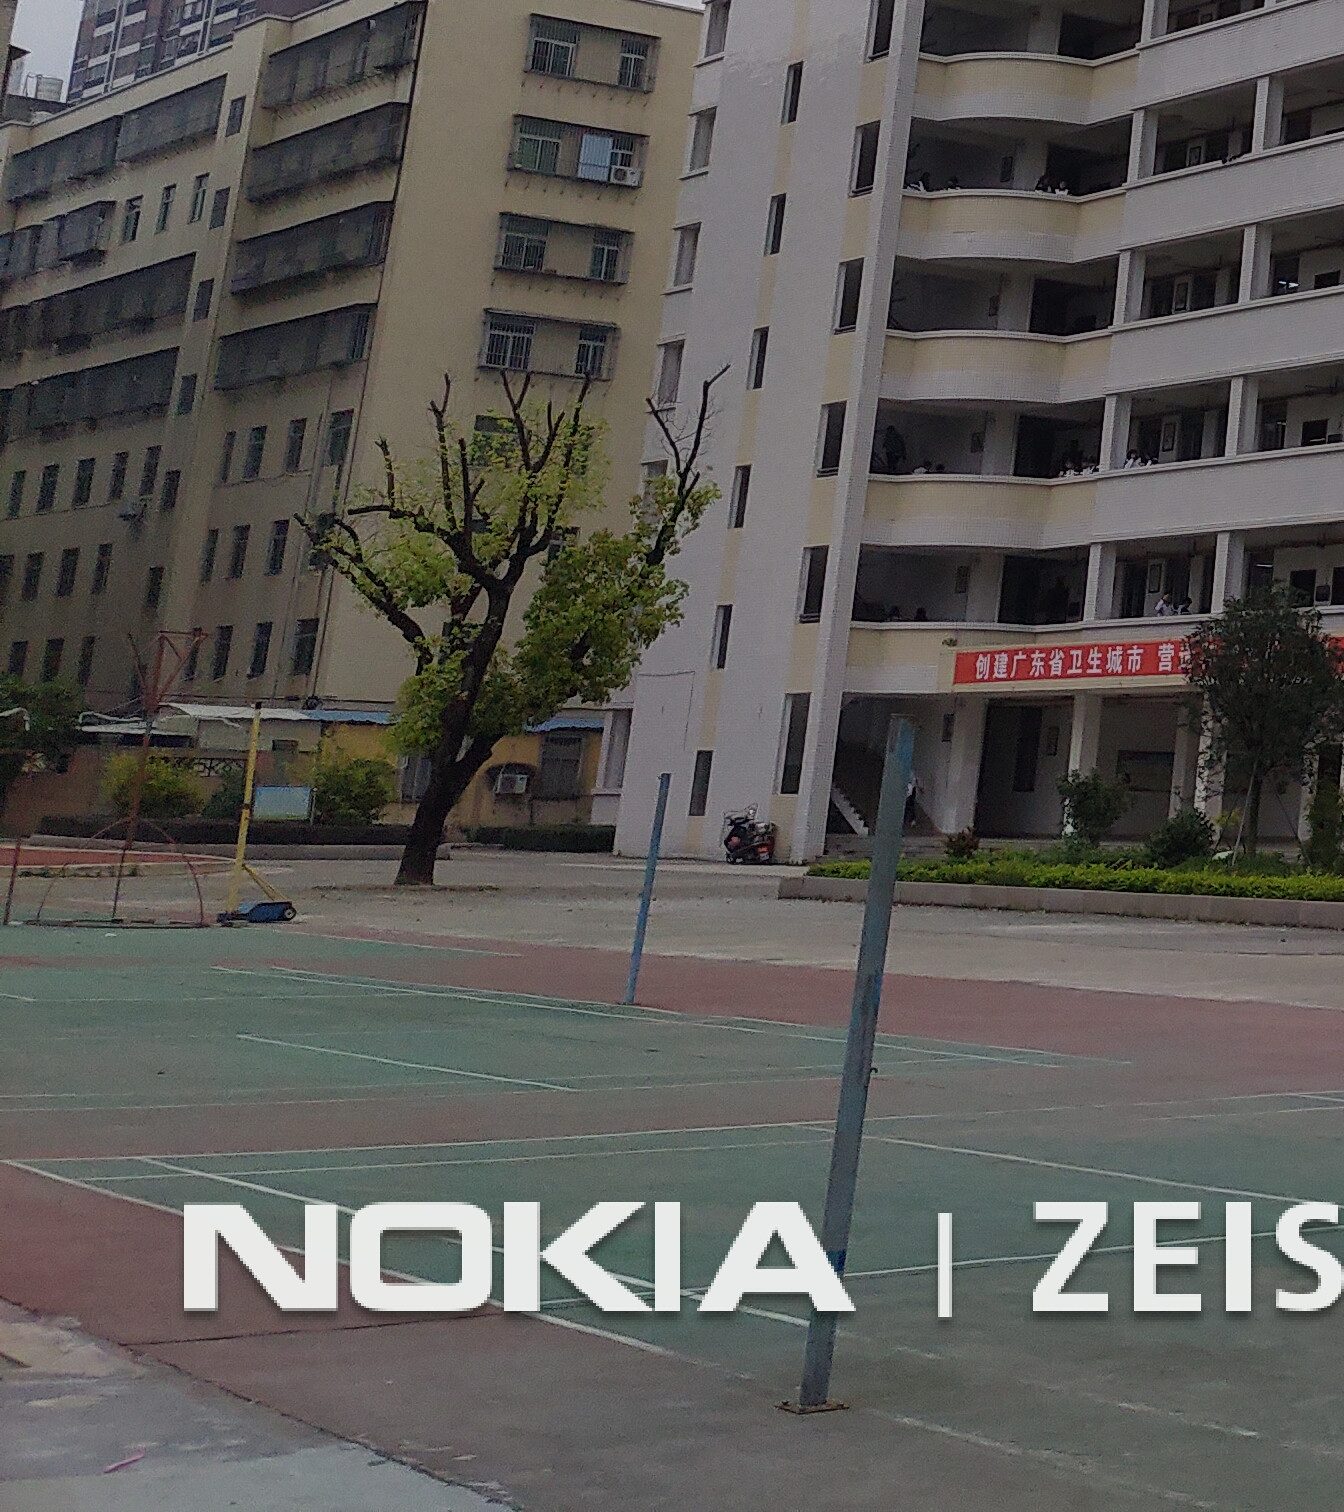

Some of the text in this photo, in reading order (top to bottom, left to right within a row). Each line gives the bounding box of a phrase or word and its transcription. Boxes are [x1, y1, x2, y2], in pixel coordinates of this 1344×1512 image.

[975, 644, 1145, 680] 创建广东省卫生城市
